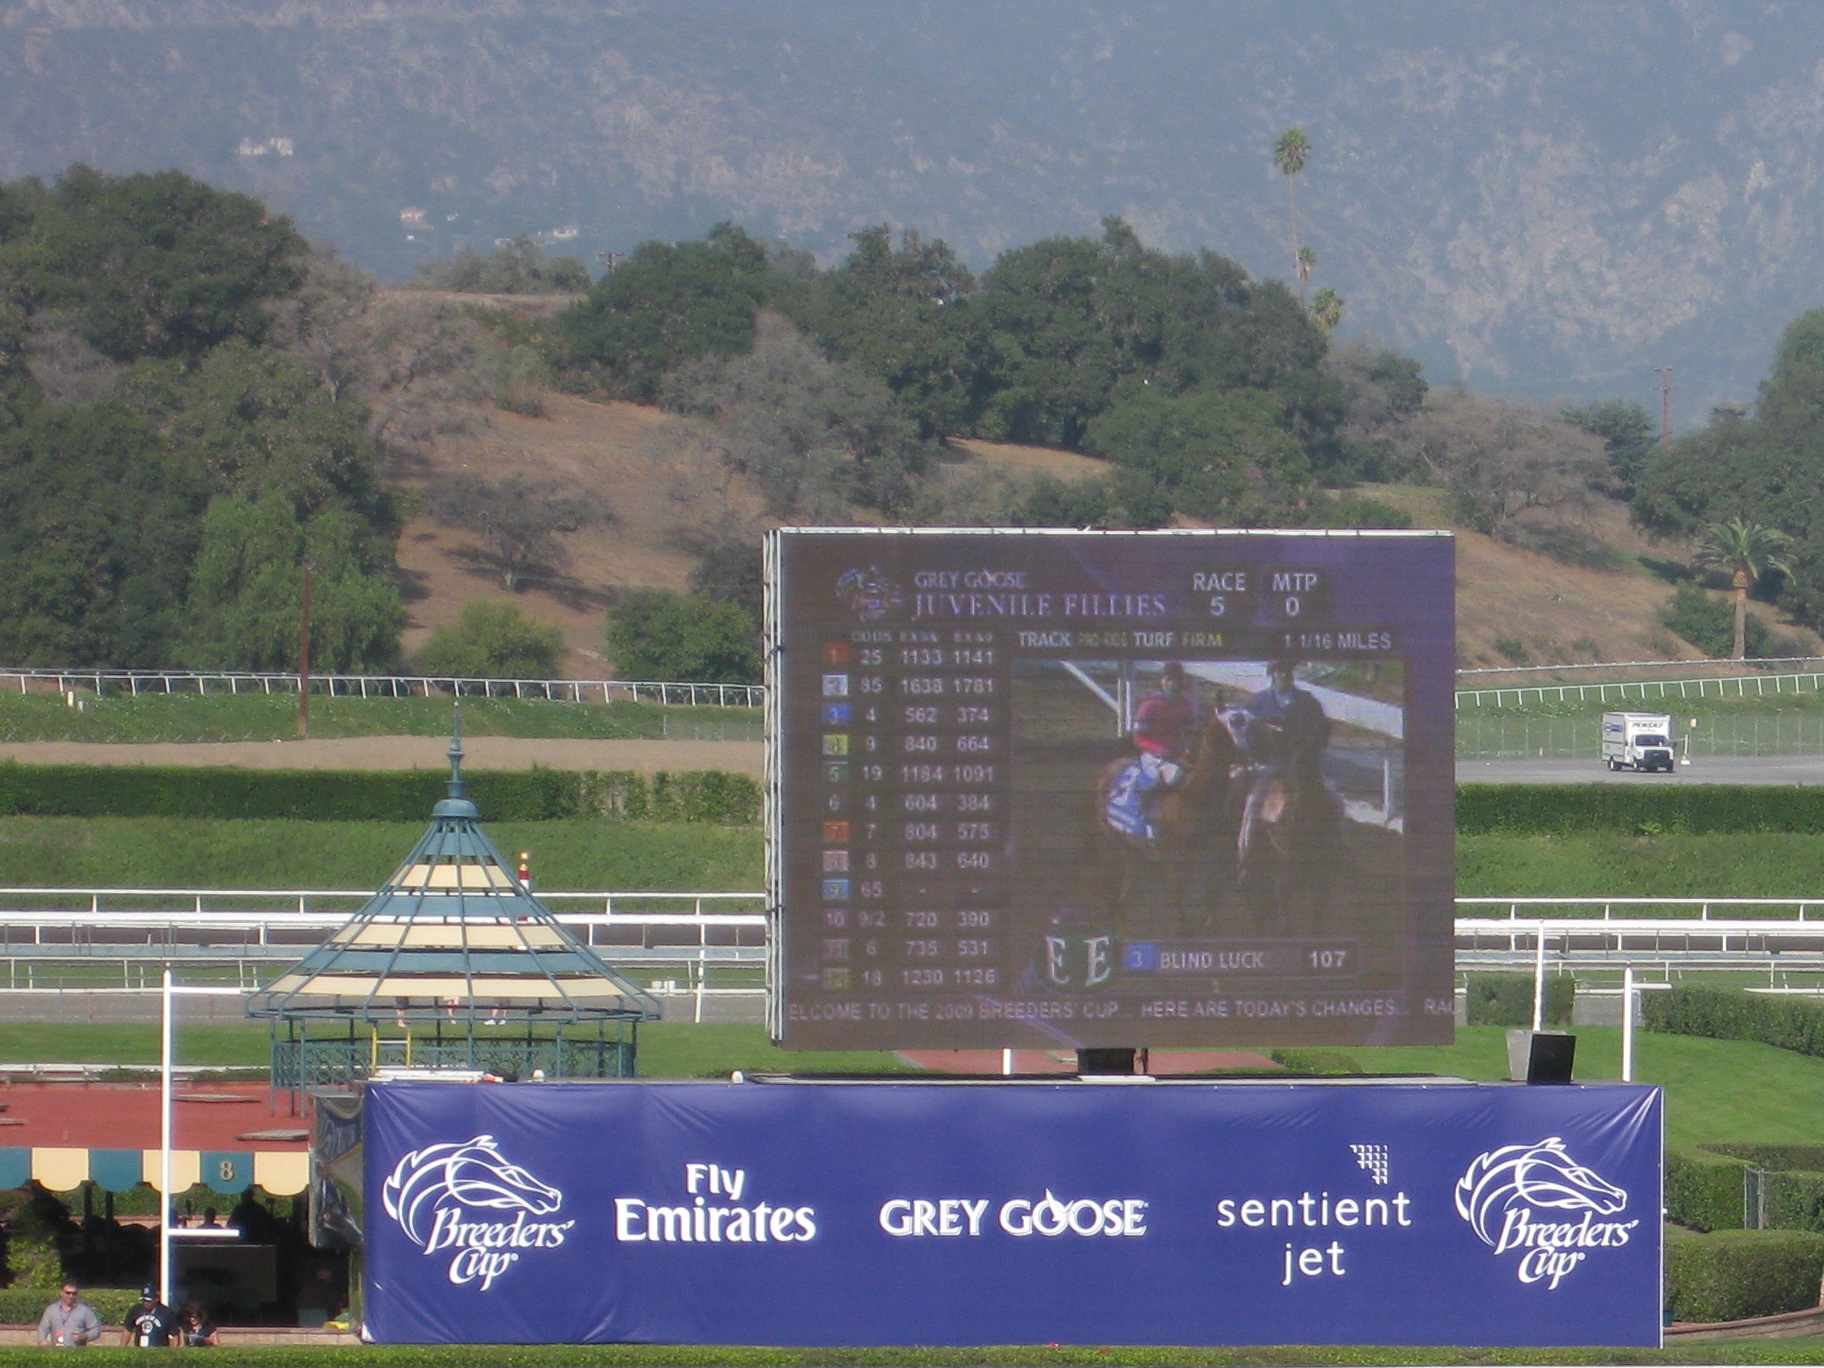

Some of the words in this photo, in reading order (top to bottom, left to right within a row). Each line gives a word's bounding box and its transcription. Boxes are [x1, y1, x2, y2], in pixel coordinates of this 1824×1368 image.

[914, 570, 959, 588] GREY
[963, 568, 1027, 588] GOOSE
[1193, 572, 1247, 592] RACE
[1271, 572, 1319, 592] MTP
[911, 593, 1052, 621] JUVENILE
[1064, 593, 1168, 616] FILLIES
[1210, 596, 1227, 617] 5
[1285, 596, 1301, 617] 0
[1018, 630, 1072, 648] TRACK
[1134, 631, 1176, 647] TURF
[1181, 632, 1223, 647] FIRM
[1284, 634, 1292, 648] 1
[1300, 633, 1333, 649] 1/16
[1337, 633, 1393, 649] MILES
[860, 649, 883, 666] 25
[901, 648, 943, 665] 1133
[954, 648, 994, 665] 1141
[860, 677, 883, 693] 85
[901, 677, 943, 694] 1638
[953, 677, 994, 693] 1781
[904, 706, 938, 722] 562
[956, 706, 991, 722] 374
[865, 735, 877, 751] 9
[904, 735, 937, 751] 840
[955, 735, 991, 751] 664
[862, 765, 883, 781] 19
[901, 765, 943, 782] 1184
[953, 765, 994, 783] 1091
[904, 794, 938, 811] 604
[956, 794, 991, 811] 384
[866, 823, 877, 839] 7
[904, 823, 938, 840] 804
[956, 823, 991, 840] 575
[904, 852, 938, 869] 843
[955, 852, 990, 869] 640
[860, 880, 883, 898] 65
[905, 911, 938, 927] 720
[956, 911, 990, 927] 390
[905, 939, 938, 956] 735
[957, 939, 988, 956] 531
[1159, 950, 1212, 969] BLIND
[1218, 950, 1265, 969] LUCK
[1308, 949, 1348, 968] 107
[902, 968, 943, 986] 1230
[953, 968, 996, 986] 1126
[867, 1002, 891, 1019] TO
[896, 1002, 929, 1019] THE
[978, 1001, 1074, 1019] BREEDERS'
[1141, 1000, 1188, 1018] HERE
[1194, 1000, 1228, 1018] ARE
[1234, 999, 1306, 1017] TODAY'S
[220, 1160, 234, 1181] 8
[684, 1163, 746, 1201] Fly
[878, 1198, 989, 1237] GREY
[999, 1187, 1149, 1237] GOOSE
[1217, 1190, 1412, 1228] sentient
[613, 1196, 817, 1243] Emirates
[422, 1207, 576, 1257] Breeders'
[1493, 1207, 1640, 1257] Breeders'
[1281, 1241, 1347, 1287] jet
